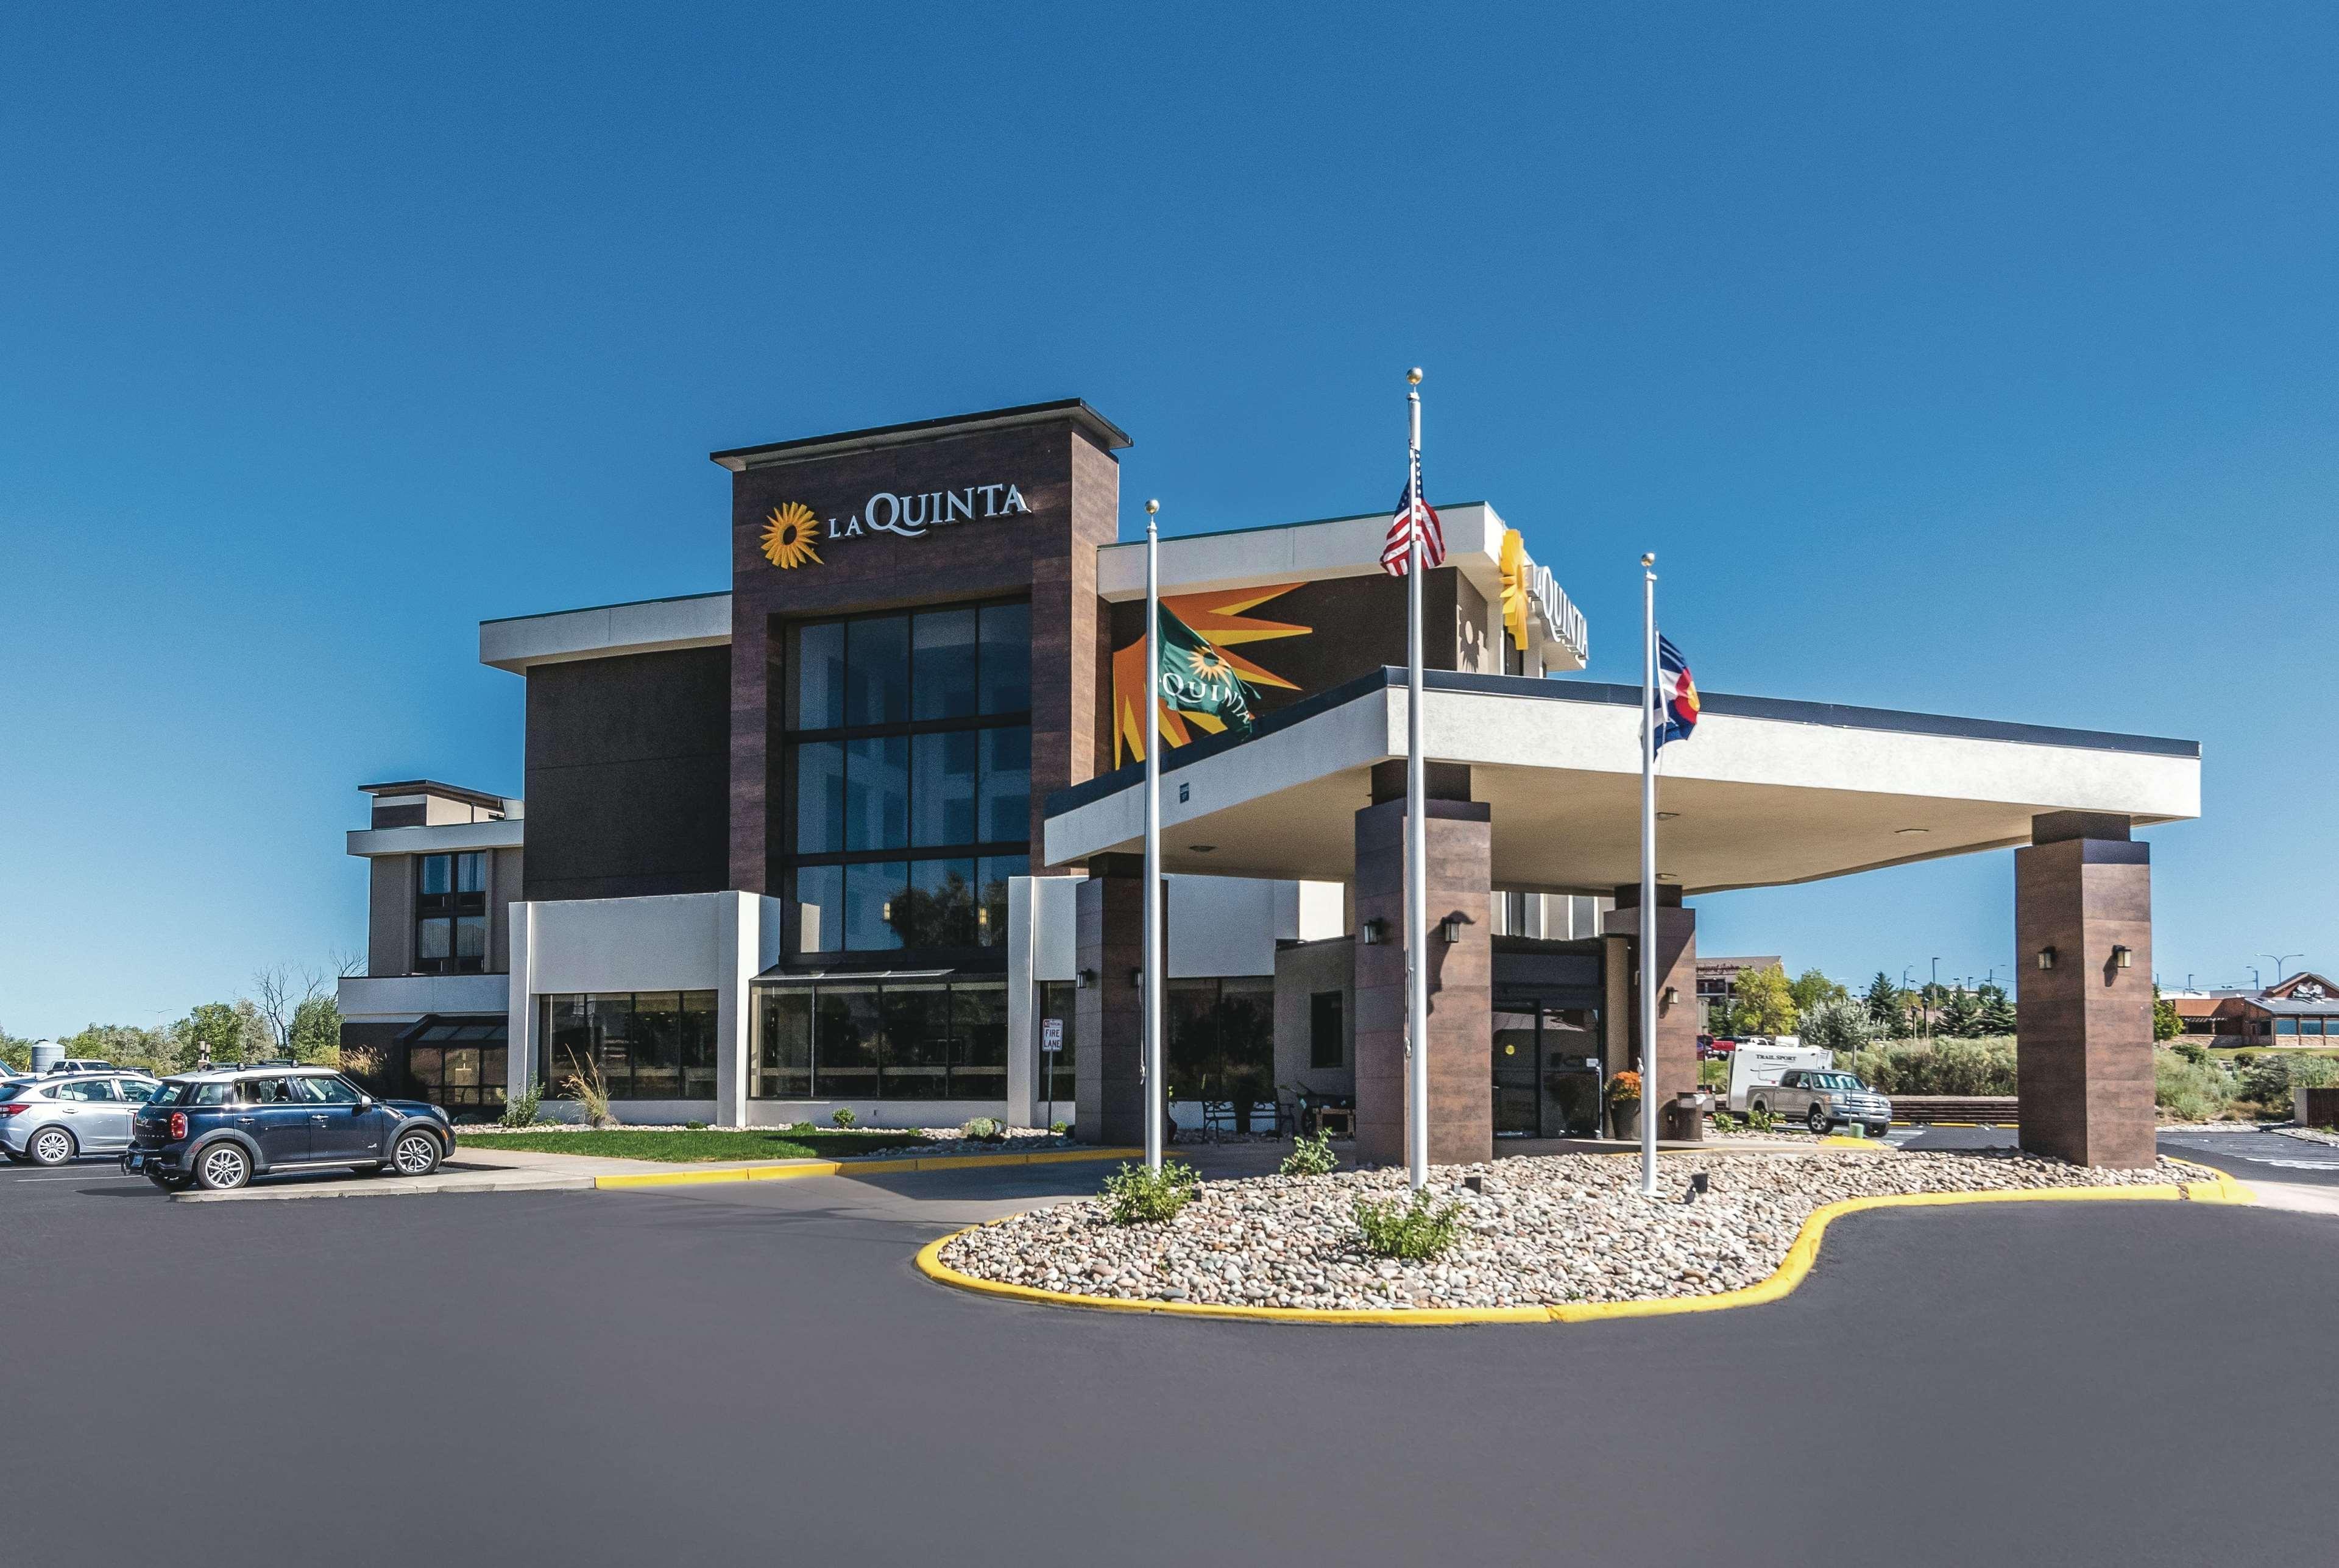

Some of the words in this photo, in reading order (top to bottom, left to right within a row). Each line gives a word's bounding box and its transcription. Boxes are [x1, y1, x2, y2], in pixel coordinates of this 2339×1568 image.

[828, 515, 863, 539] LA
[865, 484, 1032, 537] QUINTA
[1542, 565, 1590, 660] QUINTA
[1045, 1029, 1060, 1037] FIRE
